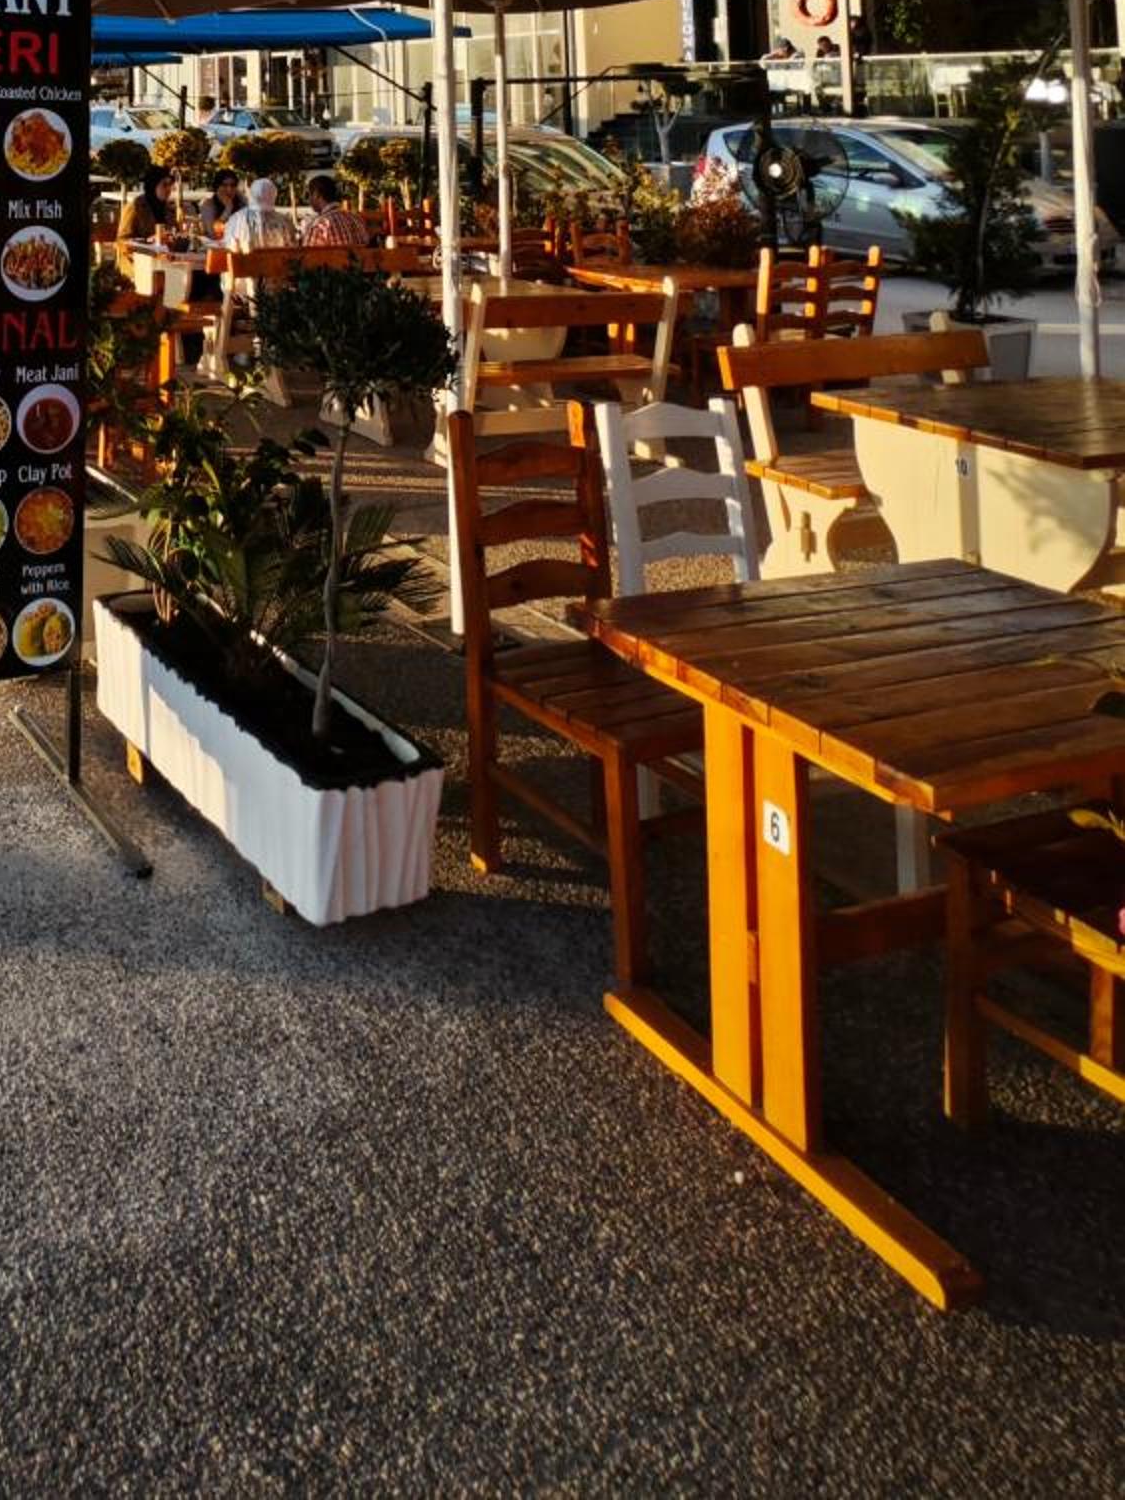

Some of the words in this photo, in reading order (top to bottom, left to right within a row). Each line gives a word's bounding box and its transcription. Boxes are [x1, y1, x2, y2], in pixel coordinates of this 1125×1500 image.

[39, 86, 81, 101] Chicken
[8, 199, 30, 219] Mix
[36, 199, 62, 219] Fish
[16, 366, 46, 383] Meat
[50, 363, 79, 381] Jani
[18, 465, 47, 485] Clay
[50, 463, 73, 480] Pot
[22, 563, 65, 578] Peppers
[20, 581, 43, 595] with
[770, 811, 780, 843] 6
